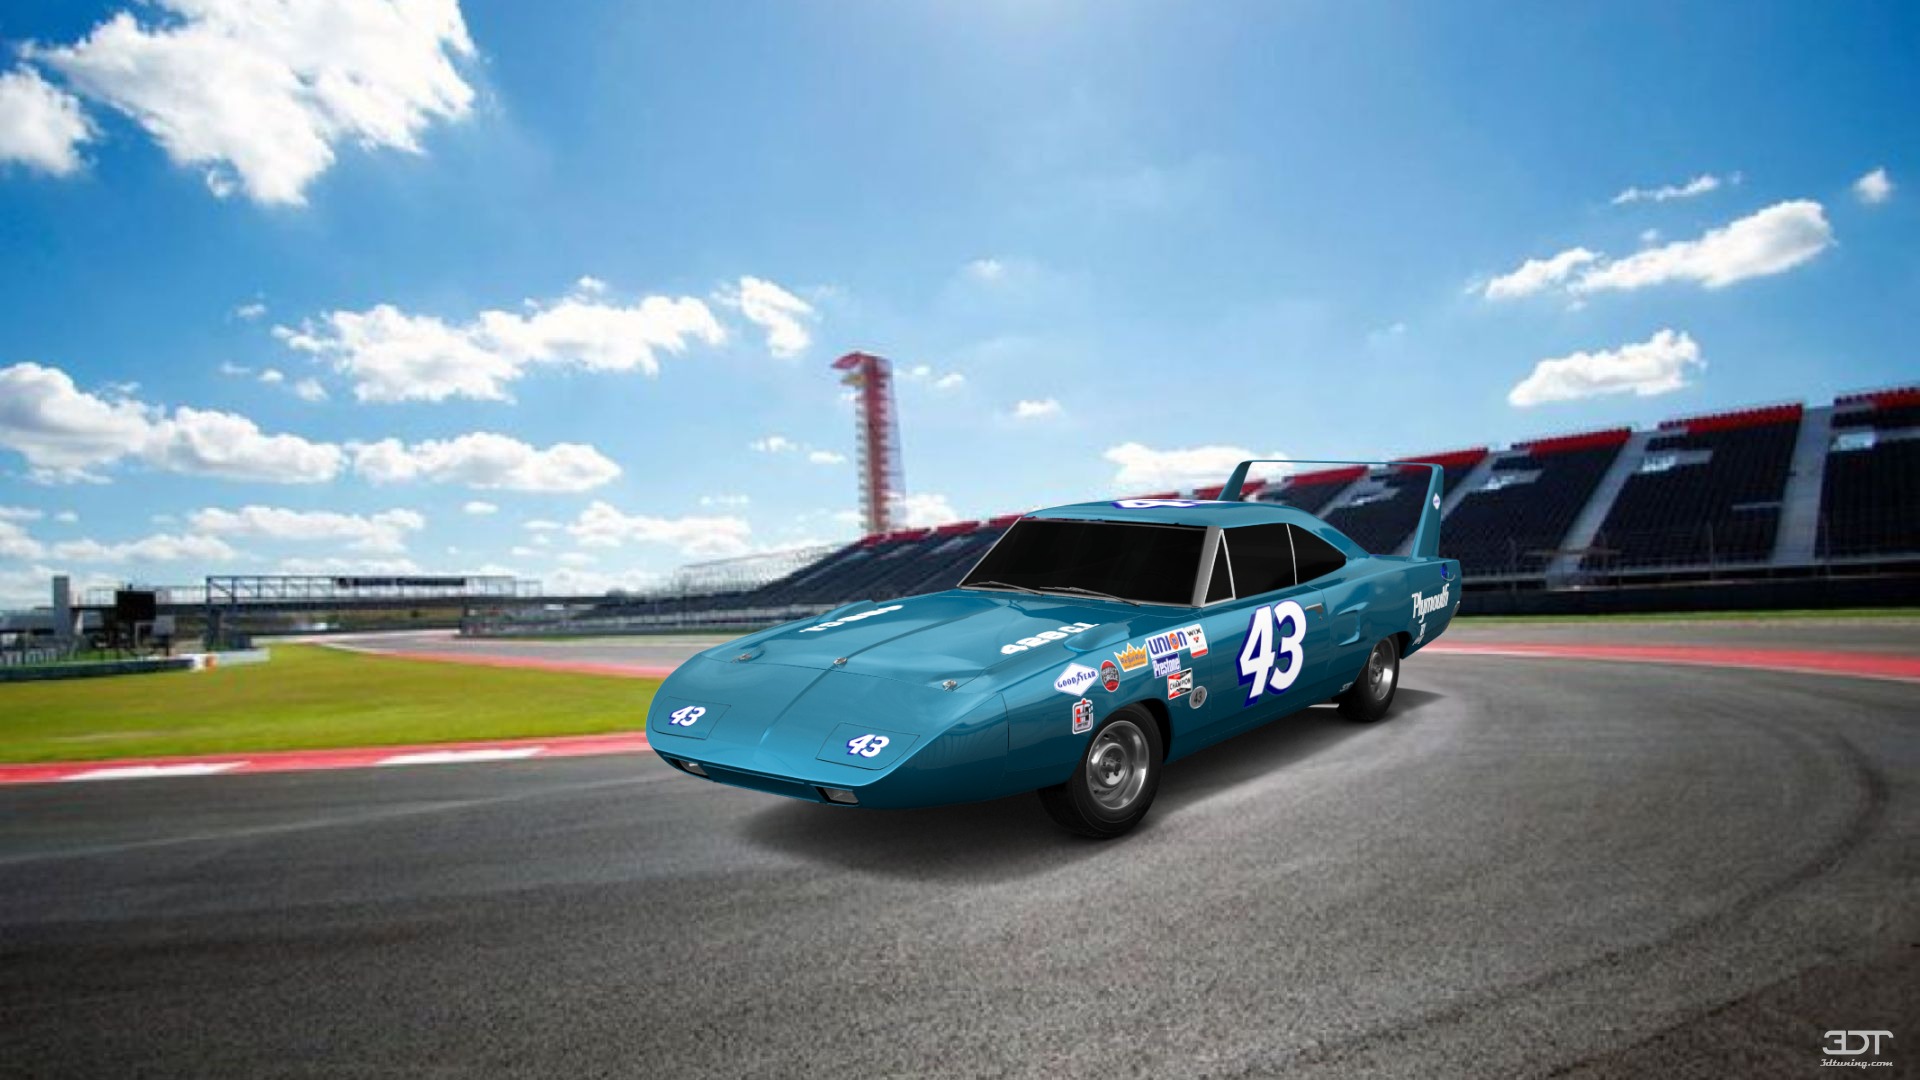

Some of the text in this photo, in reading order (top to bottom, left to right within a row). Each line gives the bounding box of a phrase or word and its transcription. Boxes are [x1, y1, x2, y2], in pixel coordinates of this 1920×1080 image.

[1411, 583, 1450, 624] Plymouth
[1148, 631, 1188, 655] UNION
[1187, 628, 1202, 637] WIX
[1236, 600, 1307, 708] 43
[1170, 677, 1191, 690] CHAMPION
[668, 704, 706, 728] 43
[846, 733, 890, 759] 43
